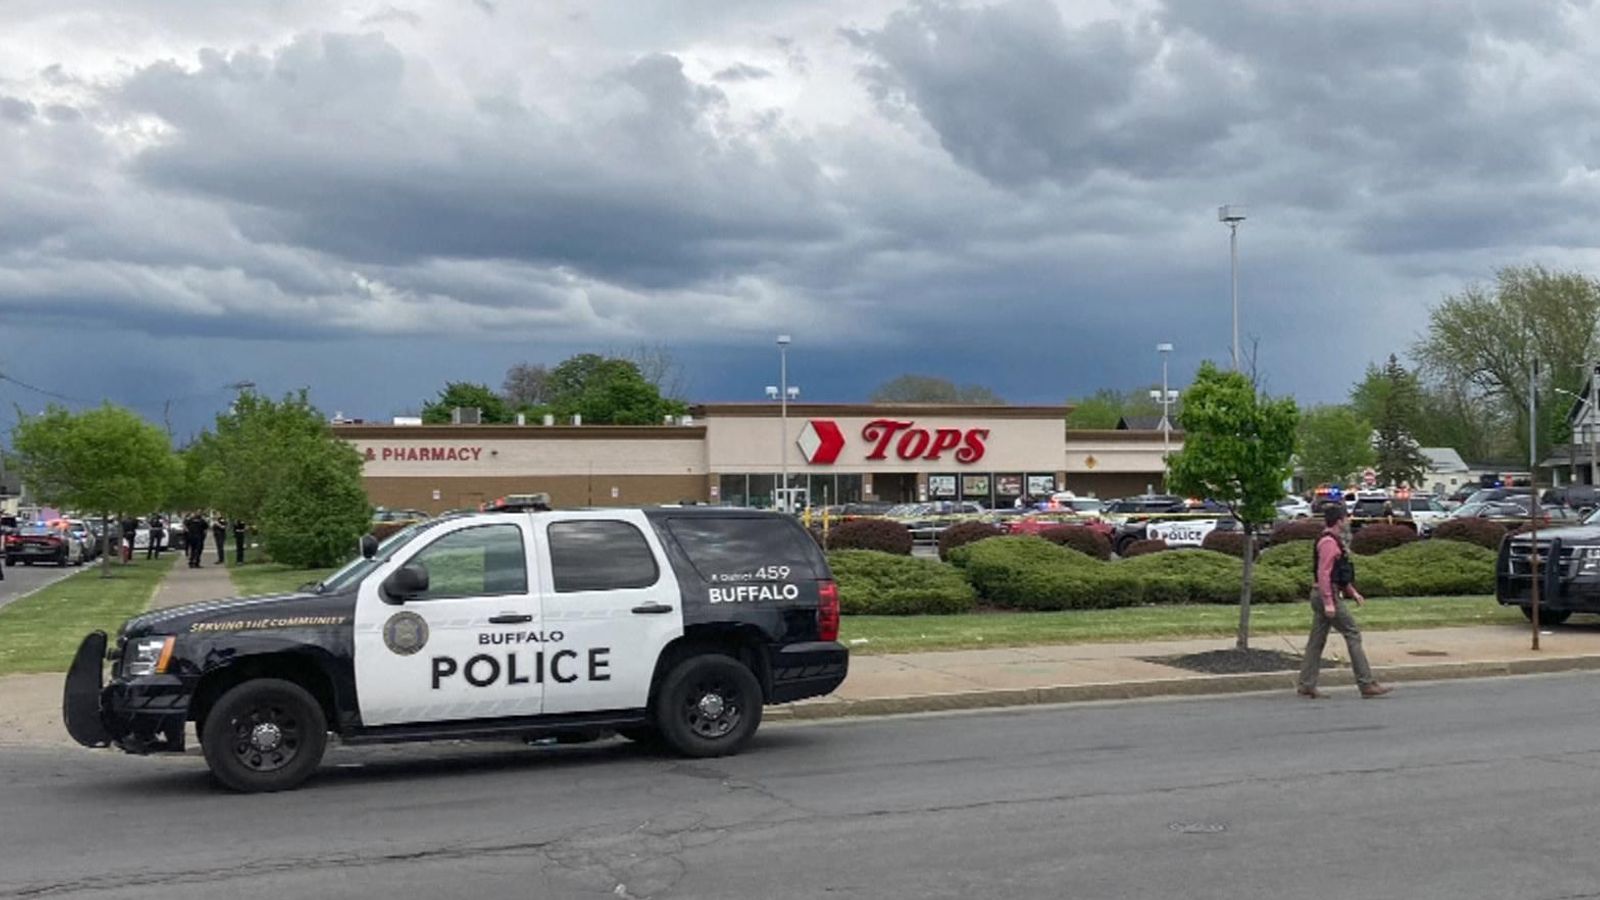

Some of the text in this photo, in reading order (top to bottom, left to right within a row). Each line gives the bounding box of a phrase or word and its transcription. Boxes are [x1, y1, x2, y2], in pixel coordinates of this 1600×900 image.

[366, 447, 482, 461] & PHARMACY
[1162, 530, 1202, 541] POLICE
[755, 566, 790, 579] 459
[708, 584, 798, 603] BUFFALO
[190, 615, 346, 633] SERVING THE COMMUNITY
[479, 630, 564, 645] BUFFALO
[431, 647, 611, 689] POLICE
